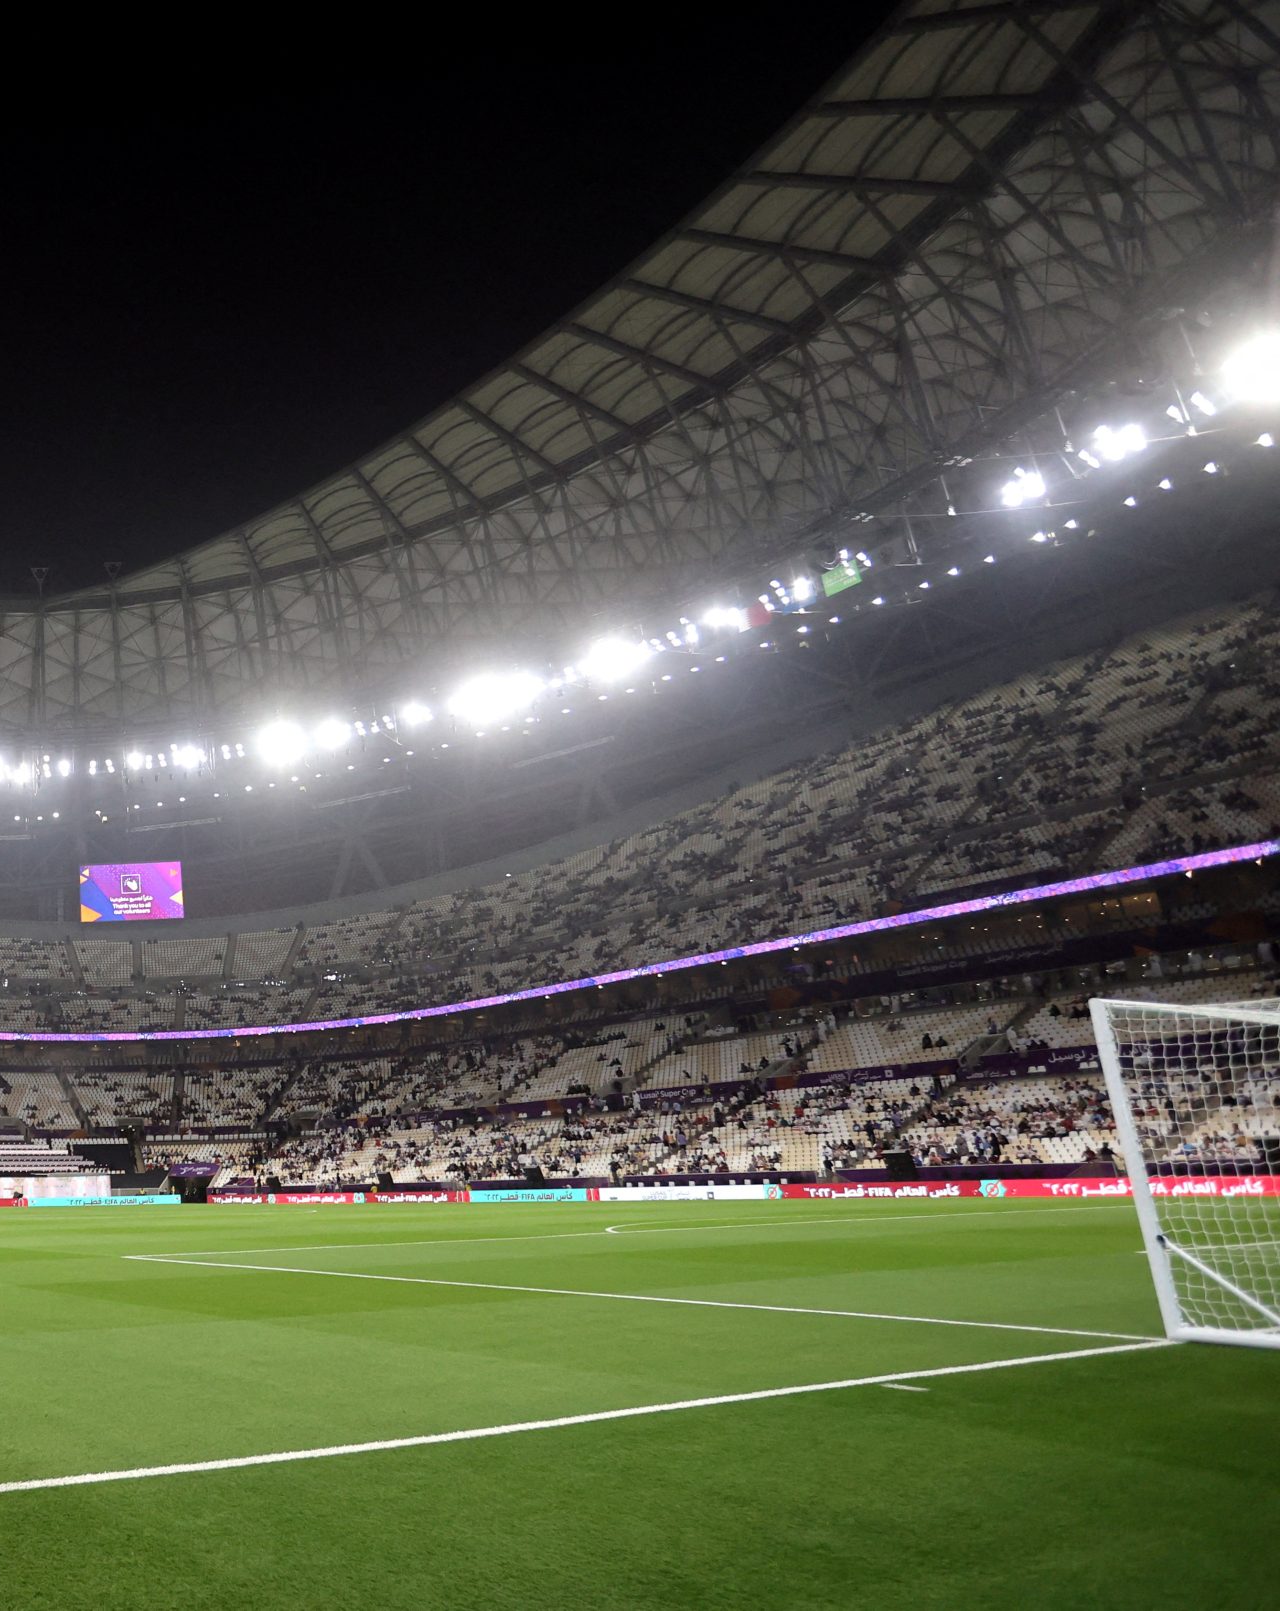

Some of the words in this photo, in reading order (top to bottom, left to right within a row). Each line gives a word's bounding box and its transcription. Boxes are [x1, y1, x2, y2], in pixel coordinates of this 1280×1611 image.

[660, 1090, 680, 1098] Super
[895, 1186, 926, 1198] العالم
[930, 1184, 960, 1198] كأس
[1173, 1182, 1215, 1196] العالم
[1221, 1179, 1264, 1196] كأس
[537, 1193, 554, 1201] العالم
[557, 1192, 572, 1201] كأس
